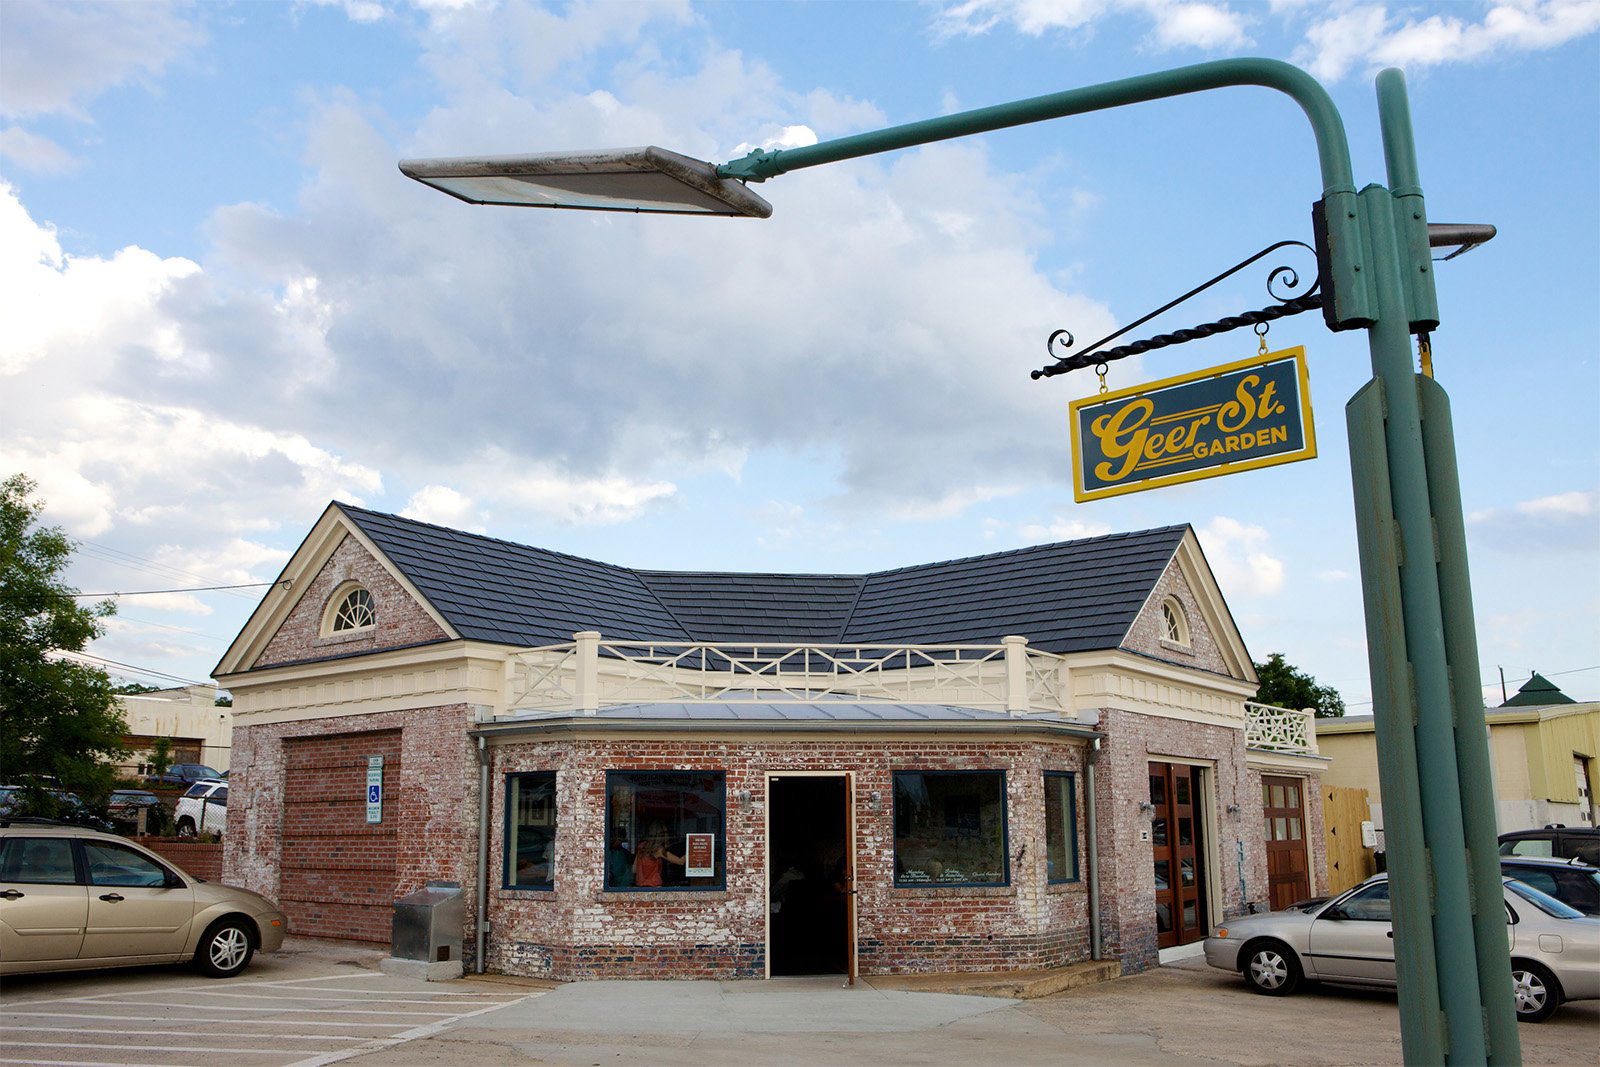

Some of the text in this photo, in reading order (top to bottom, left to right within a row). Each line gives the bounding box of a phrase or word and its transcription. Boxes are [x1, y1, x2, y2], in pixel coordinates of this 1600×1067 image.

[1091, 375, 1286, 482] Geer St.
[1193, 425, 1287, 459] GARDEN
